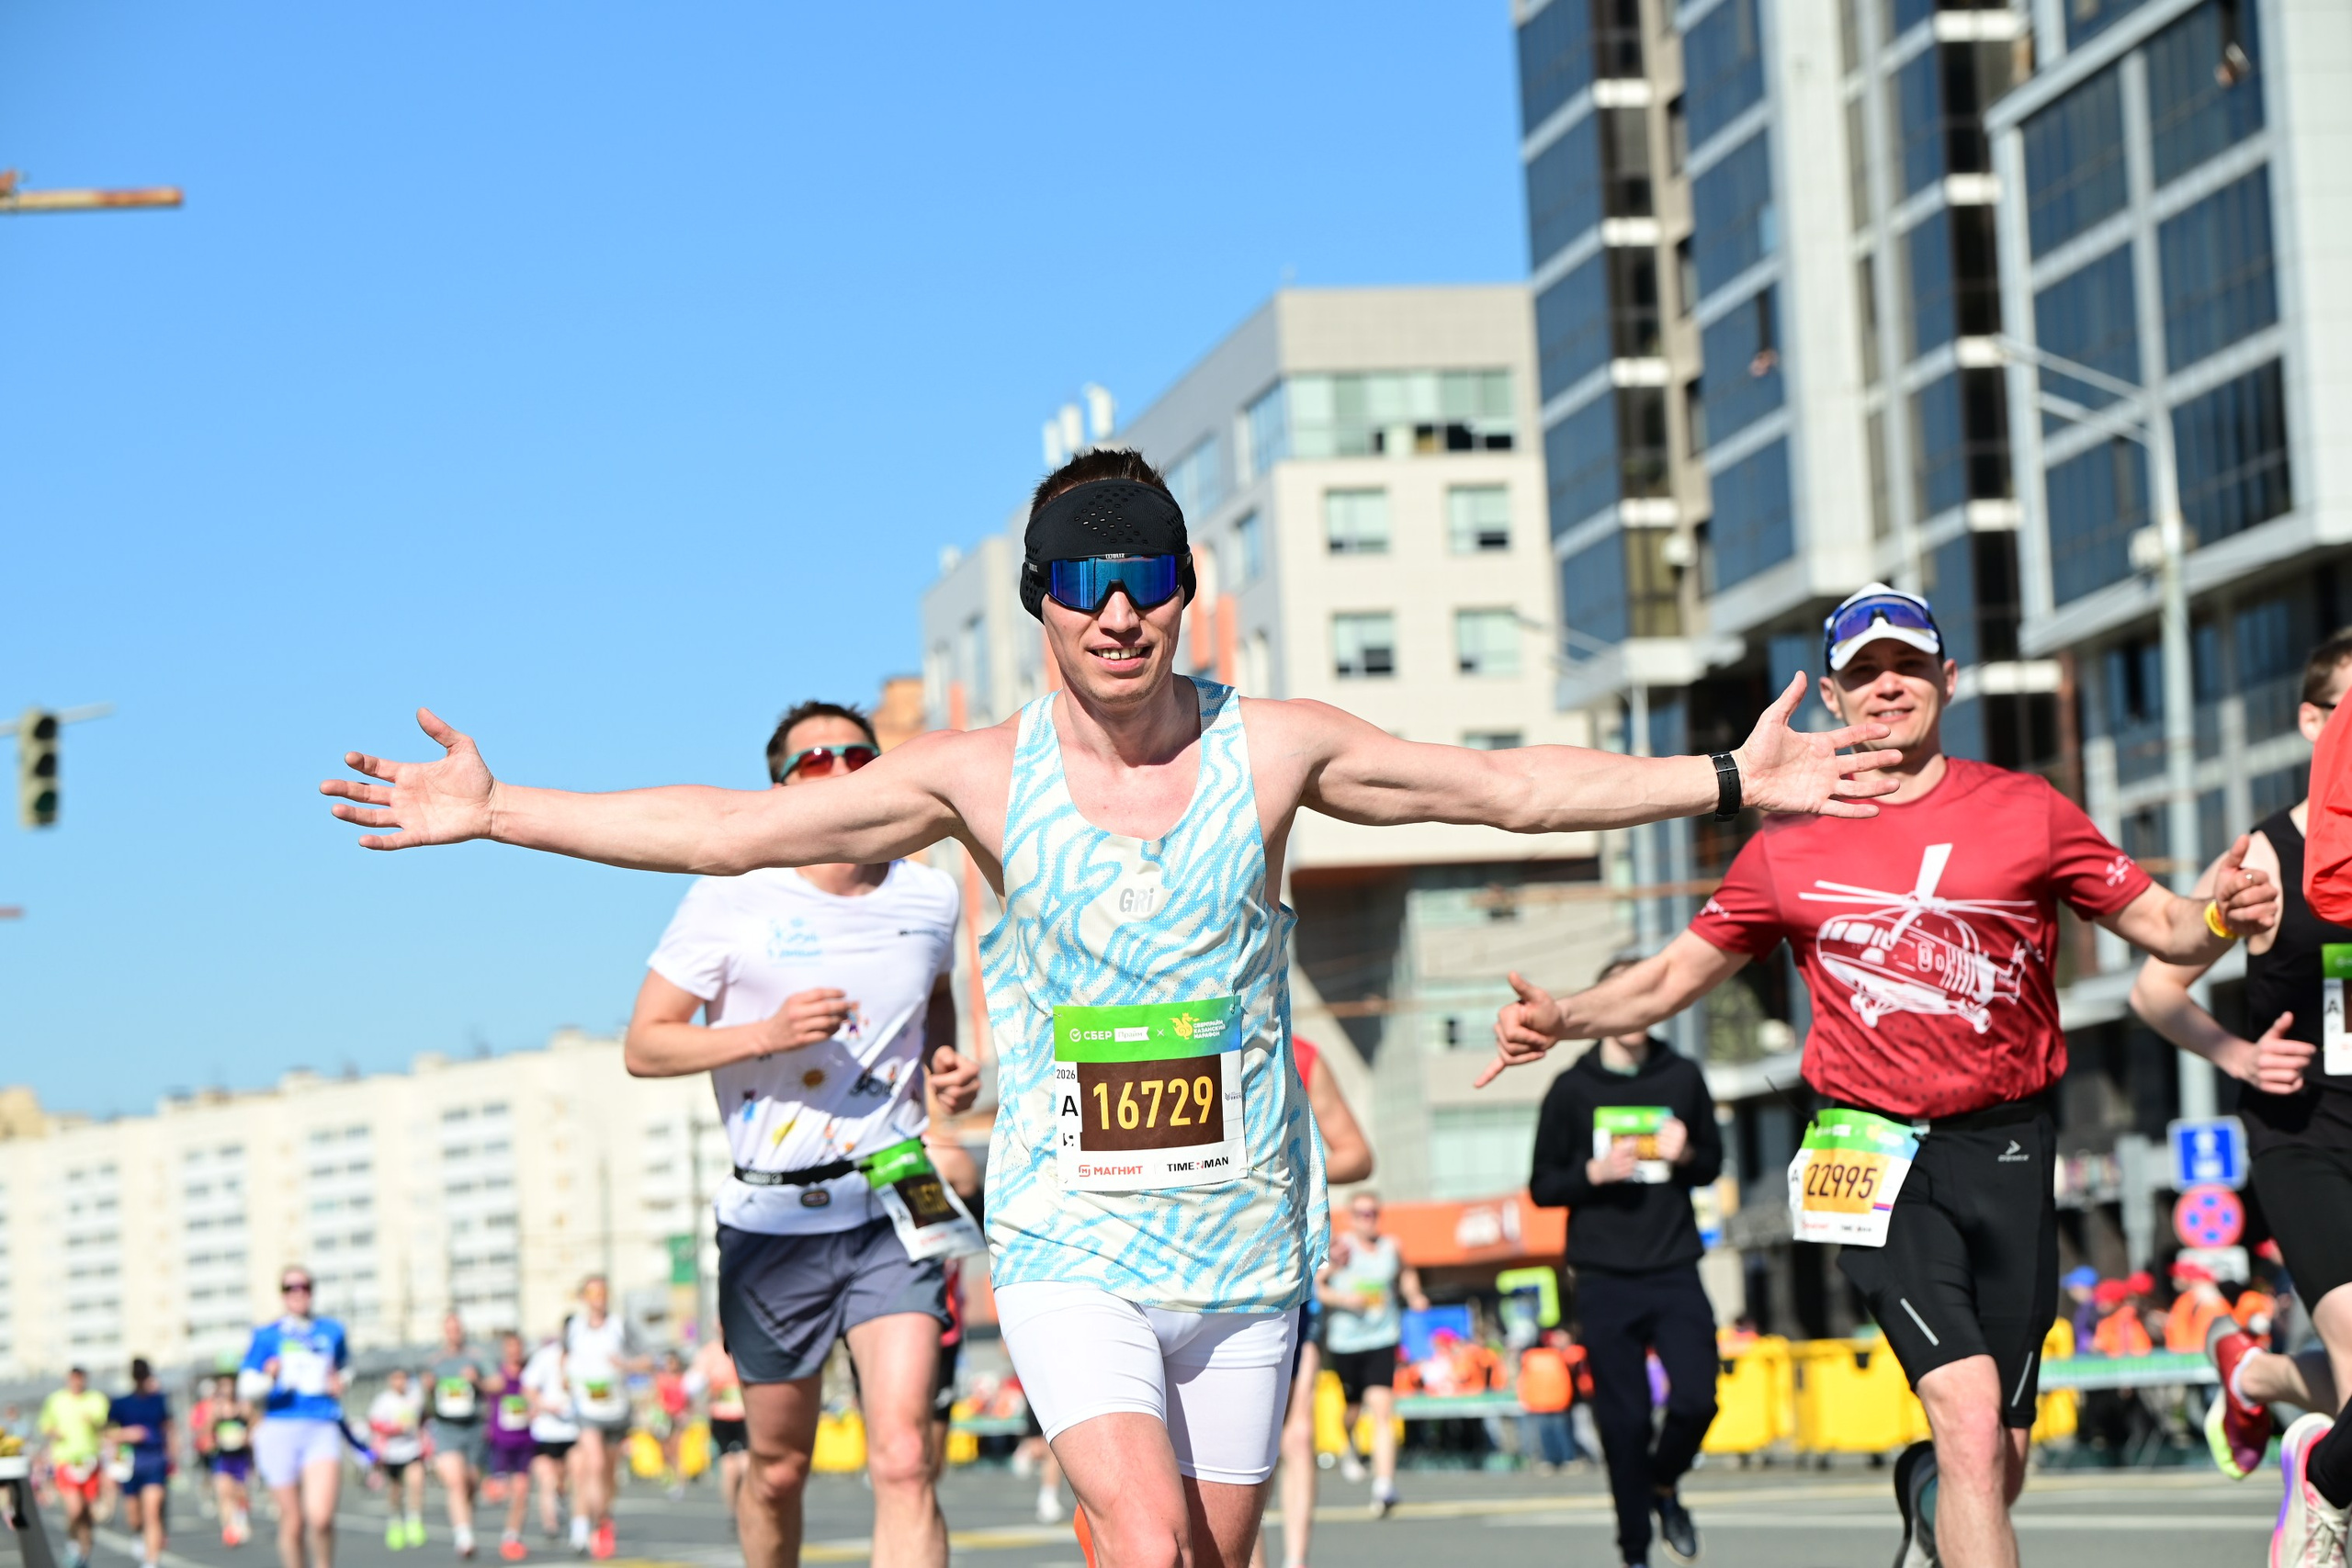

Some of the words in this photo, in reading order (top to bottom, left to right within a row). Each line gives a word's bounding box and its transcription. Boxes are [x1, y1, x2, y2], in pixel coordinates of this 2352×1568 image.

[1083, 1031, 1113, 1041] СБЕР
[1057, 1069, 1076, 1079] 2026
[1061, 1095, 1079, 1117] A
[1092, 1076, 1214, 1130] 16729
[1093, 1166, 1143, 1176] МАГНИТ
[1807, 1164, 1878, 1199] 22995
